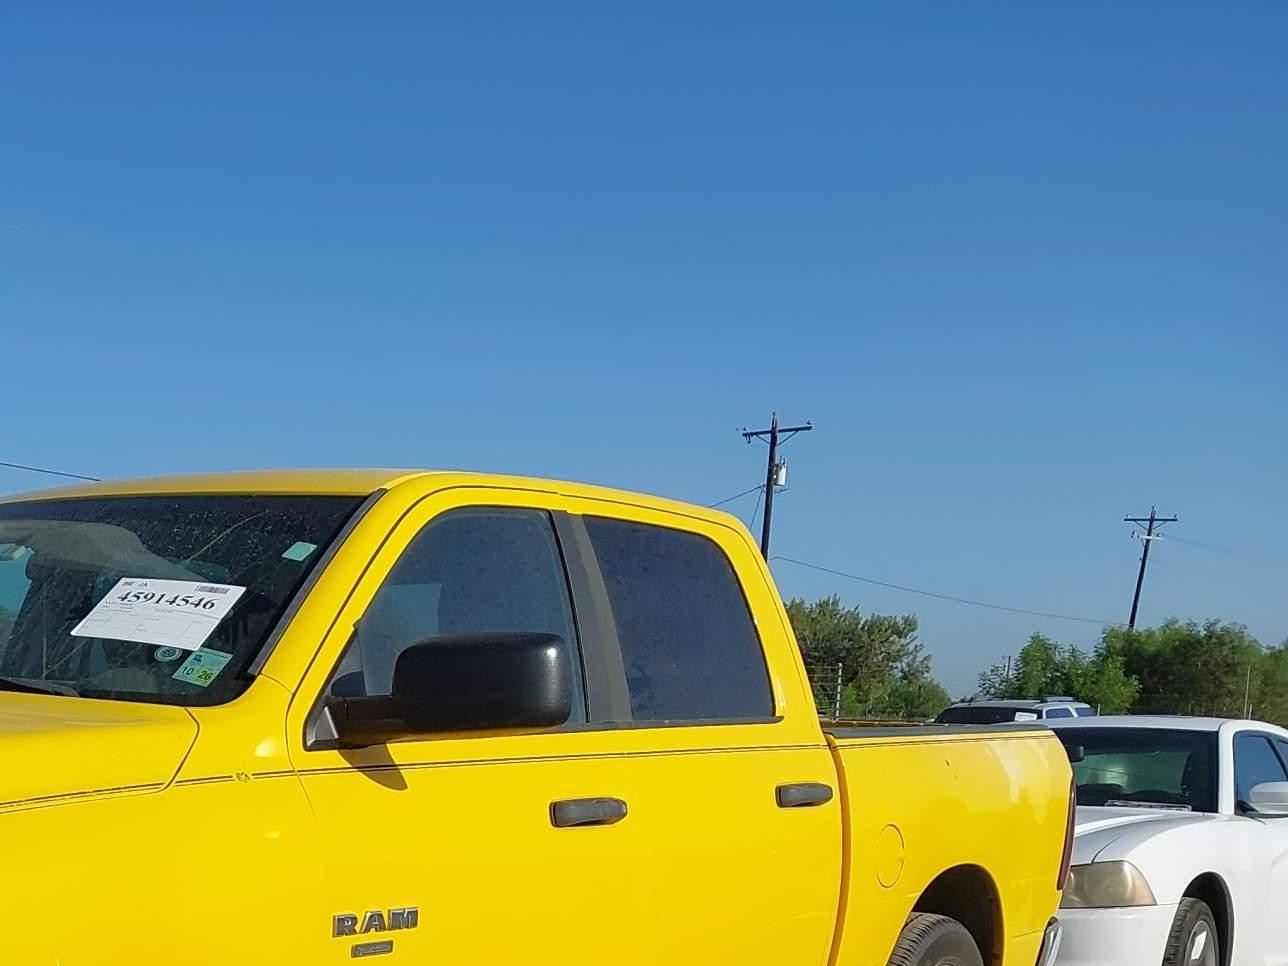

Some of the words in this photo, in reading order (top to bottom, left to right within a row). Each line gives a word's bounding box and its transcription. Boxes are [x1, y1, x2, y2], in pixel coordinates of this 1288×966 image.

[117, 590, 218, 610] 45914546
[181, 666, 195, 676] 10
[198, 670, 214, 681] 26
[332, 906, 419, 938] RAM
